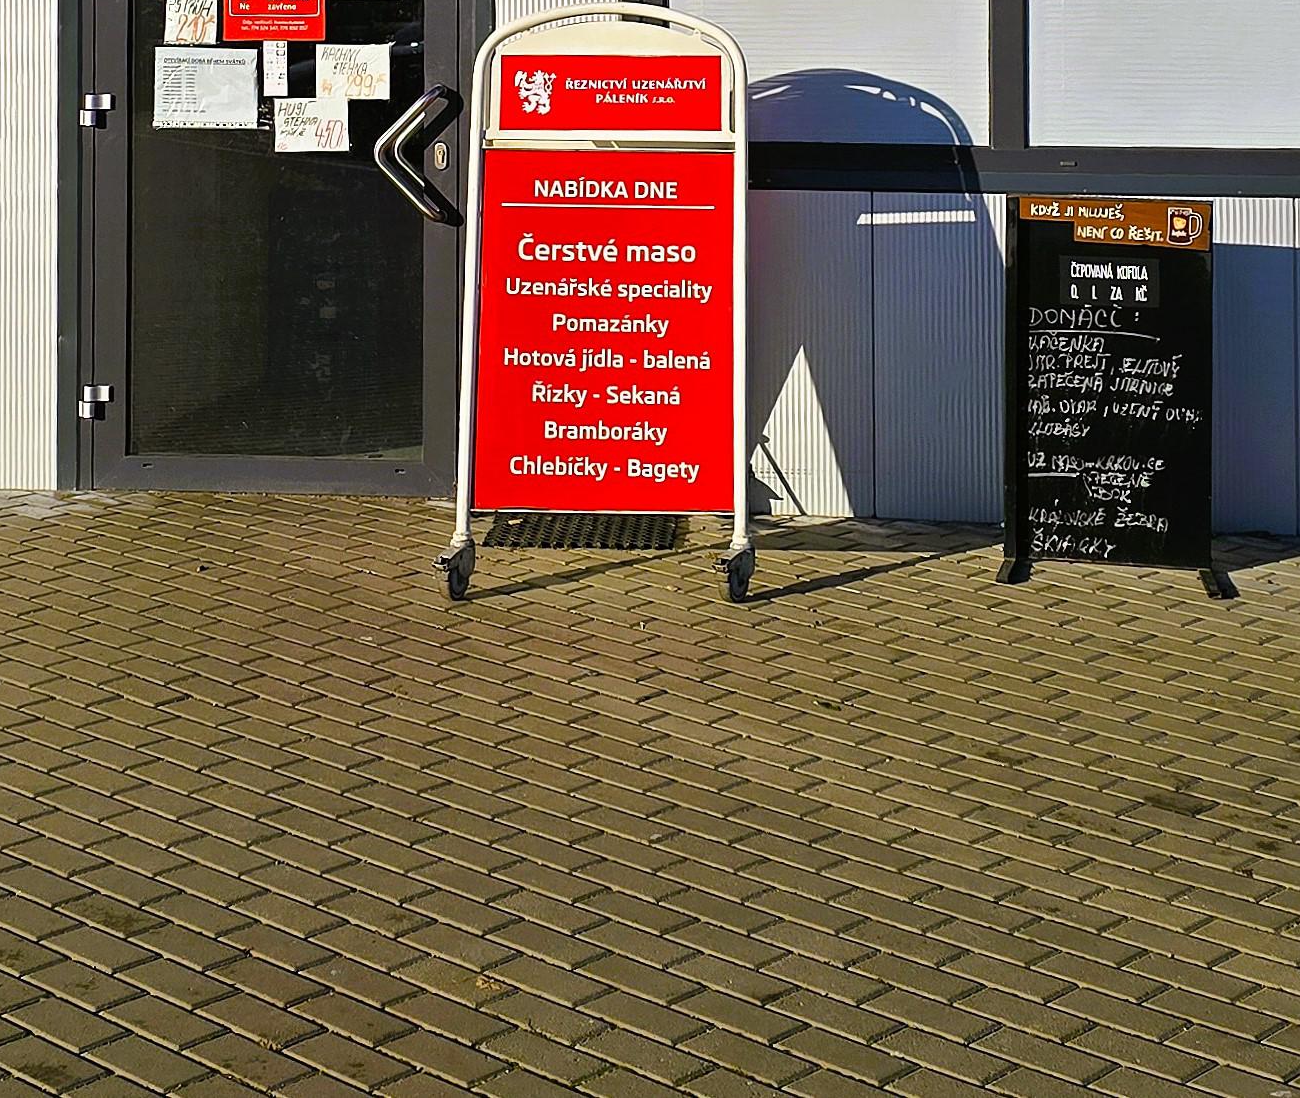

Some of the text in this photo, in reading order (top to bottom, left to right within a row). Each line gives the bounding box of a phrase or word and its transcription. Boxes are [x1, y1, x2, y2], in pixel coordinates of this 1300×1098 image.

[565, 76, 706, 91] ŘEZNICTVÍ UZENÁŘSTVÍ
[595, 90, 649, 105] PÁLENÍK
[533, 177, 678, 200] NABÍDKA DNE
[1031, 202, 1061, 217] KDYŽ
[1064, 205, 1074, 217] JI
[1076, 225, 1164, 243] NENÍ CO ŘEŠIT.
[517, 233, 697, 264] Čerstvé maso
[1070, 261, 1149, 281] ČEPOVANÁ KOFOLA
[505, 277, 712, 304] Uzenářské speciality
[1110, 286, 1124, 301] ZA
[552, 313, 669, 339] Pomazánky
[503, 348, 577, 368] Hotová
[579, 348, 624, 372] jídla
[643, 350, 711, 371] balená
[531, 381, 588, 408] Řízky
[606, 385, 681, 406] Sekaná
[543, 420, 667, 446] Bramboráky
[509, 456, 608, 480] Chlebíčky
[627, 459, 699, 484] Bagety
